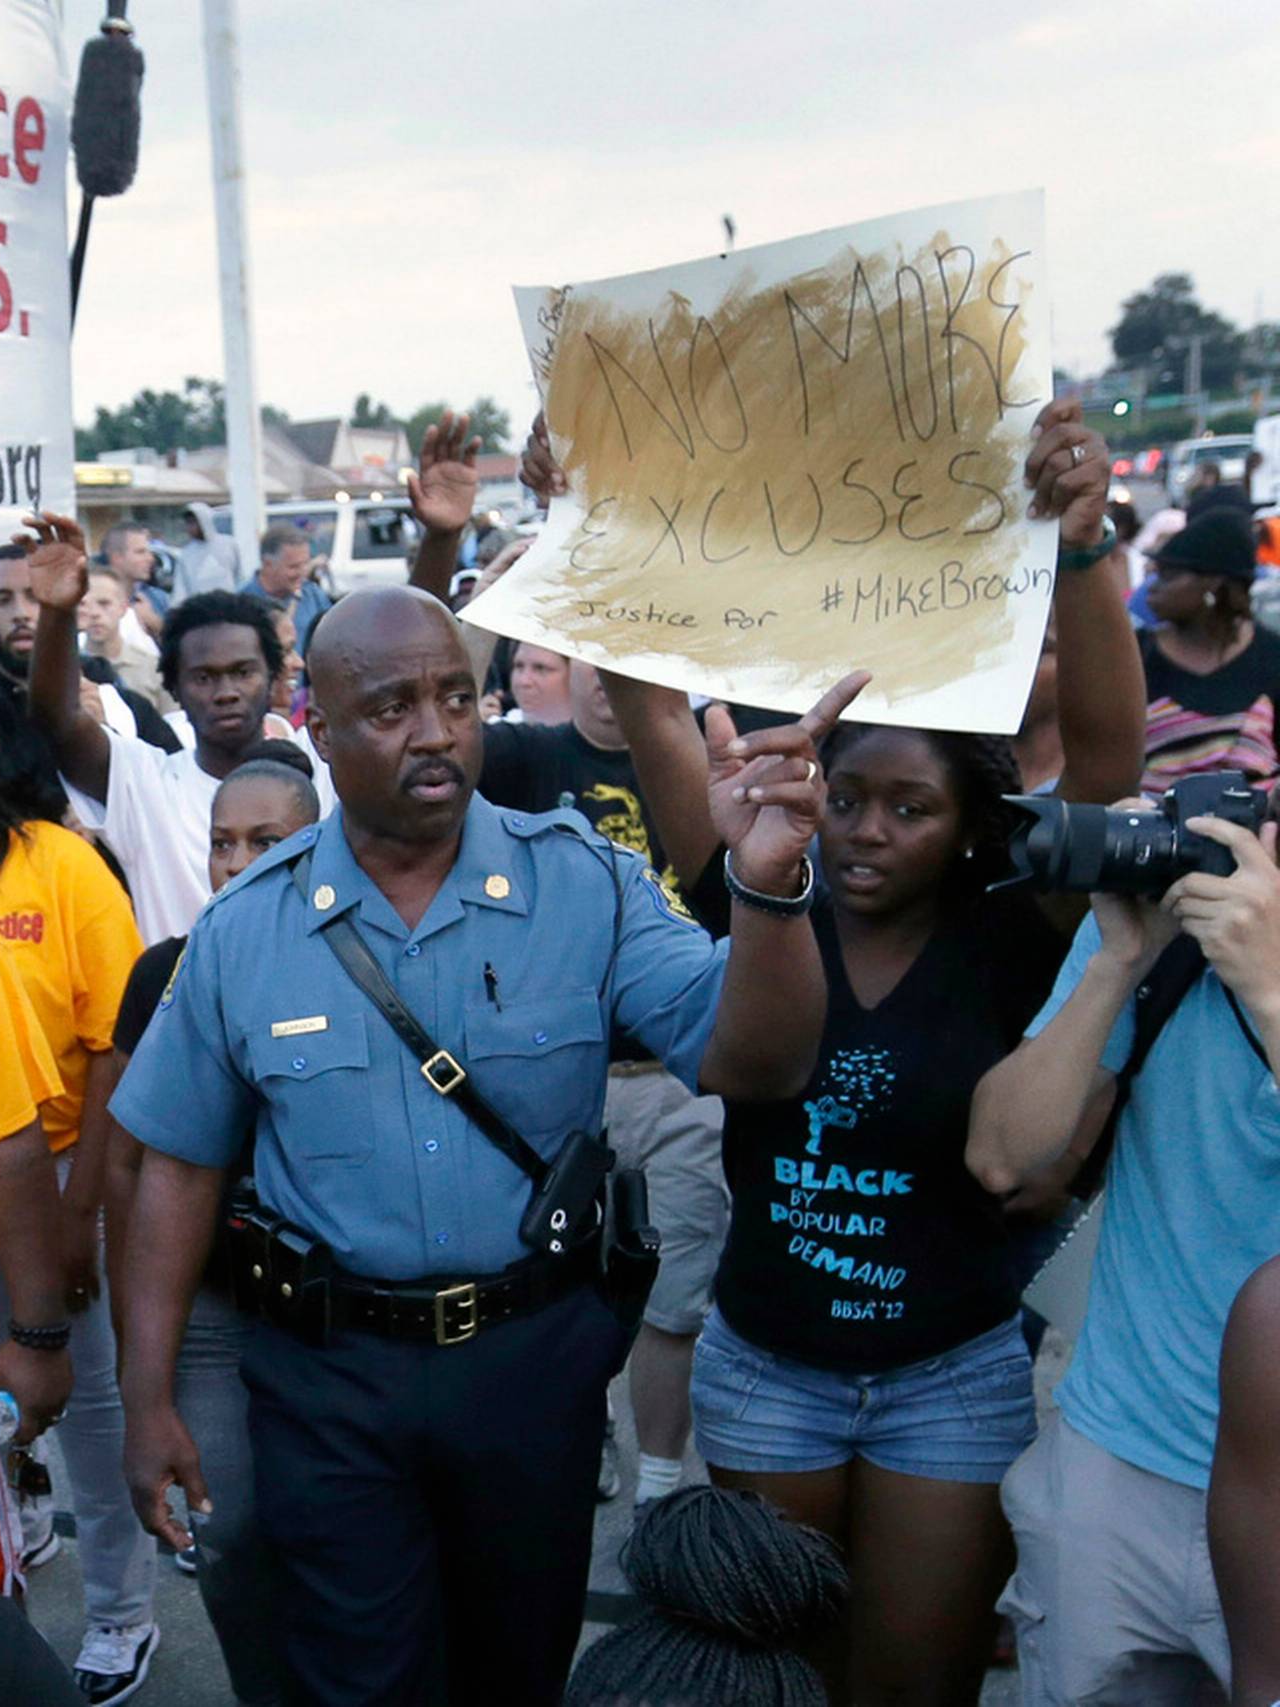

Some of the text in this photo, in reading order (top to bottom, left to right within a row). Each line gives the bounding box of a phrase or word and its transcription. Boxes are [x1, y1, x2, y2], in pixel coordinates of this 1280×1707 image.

[585, 245, 1040, 462] NO MORE
[571, 451, 1005, 572] EXCUSES
[578, 601, 699, 628] Justice
[774, 1157, 914, 1196] BLACK
[790, 1189, 818, 1208] BY
[770, 1202, 886, 1236] POPULAR
[788, 1235, 907, 1290] DEMAND
[830, 1299, 877, 1320] BBSA
